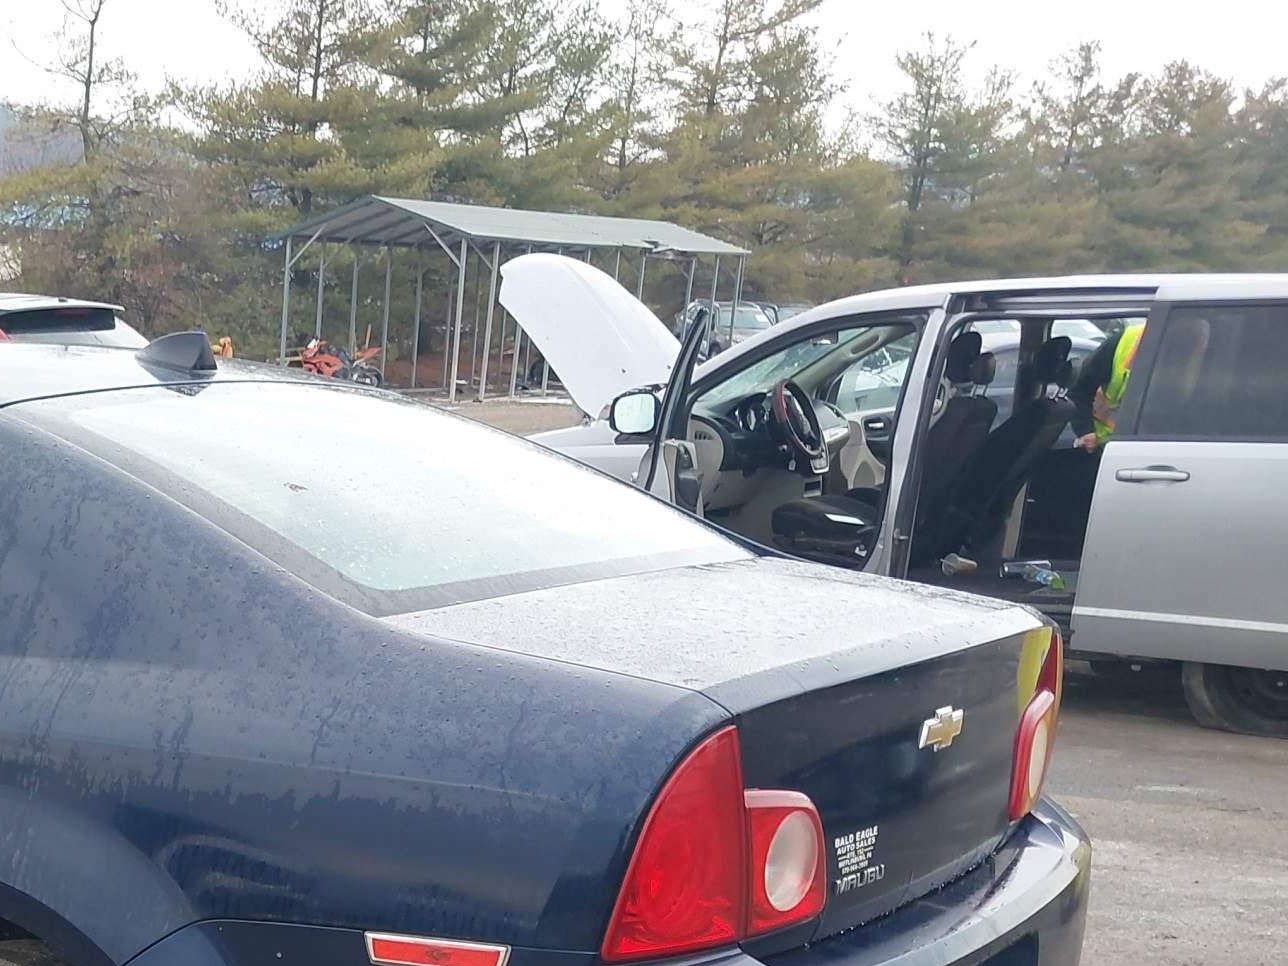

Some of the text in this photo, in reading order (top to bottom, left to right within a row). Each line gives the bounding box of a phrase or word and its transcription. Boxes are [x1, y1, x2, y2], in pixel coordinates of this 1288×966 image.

[834, 825, 879, 849] BALD EAGLE
[836, 843, 856, 856] AUTO
[855, 836, 876, 849] SALES
[835, 864, 885, 896] MALIBU
